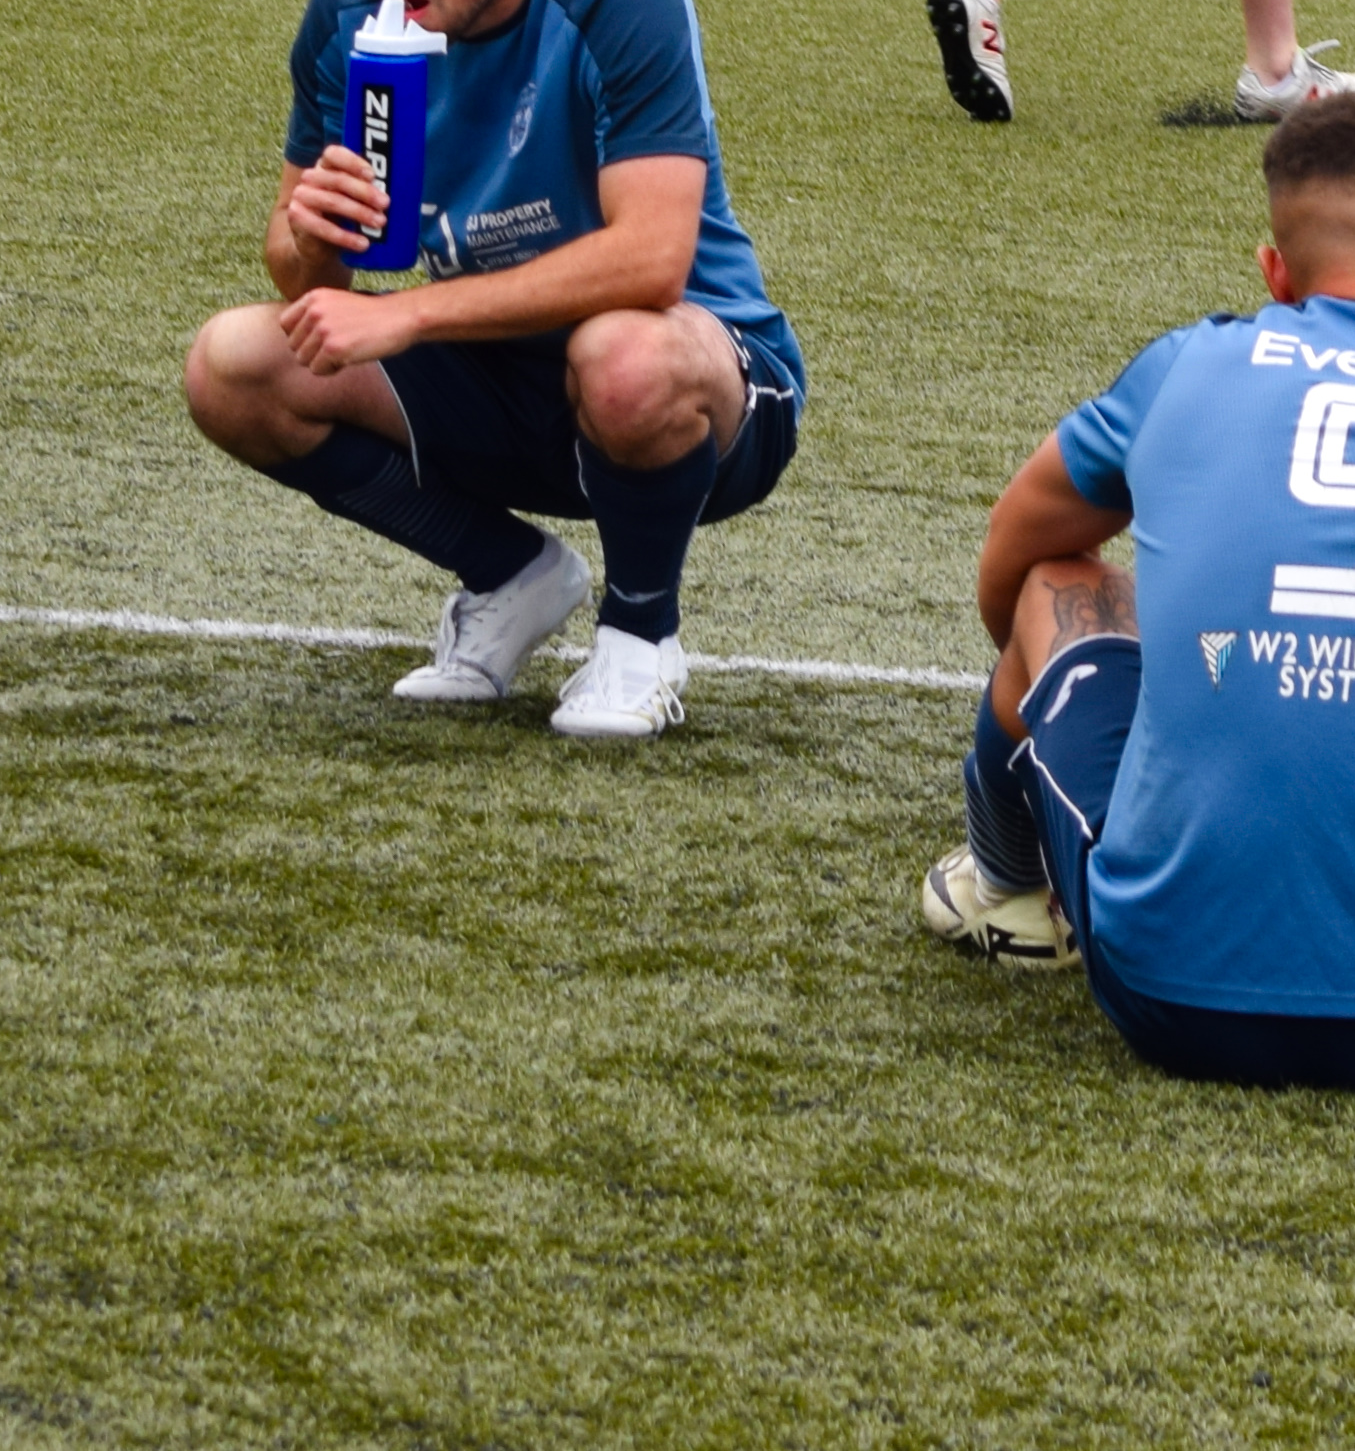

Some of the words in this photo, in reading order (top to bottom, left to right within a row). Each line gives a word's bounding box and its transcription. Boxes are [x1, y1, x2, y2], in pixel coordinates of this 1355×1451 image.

[466, 214, 562, 247] MAINTENANCE
[480, 198, 552, 230] PROPERTY
[1249, 629, 1298, 665] W2
